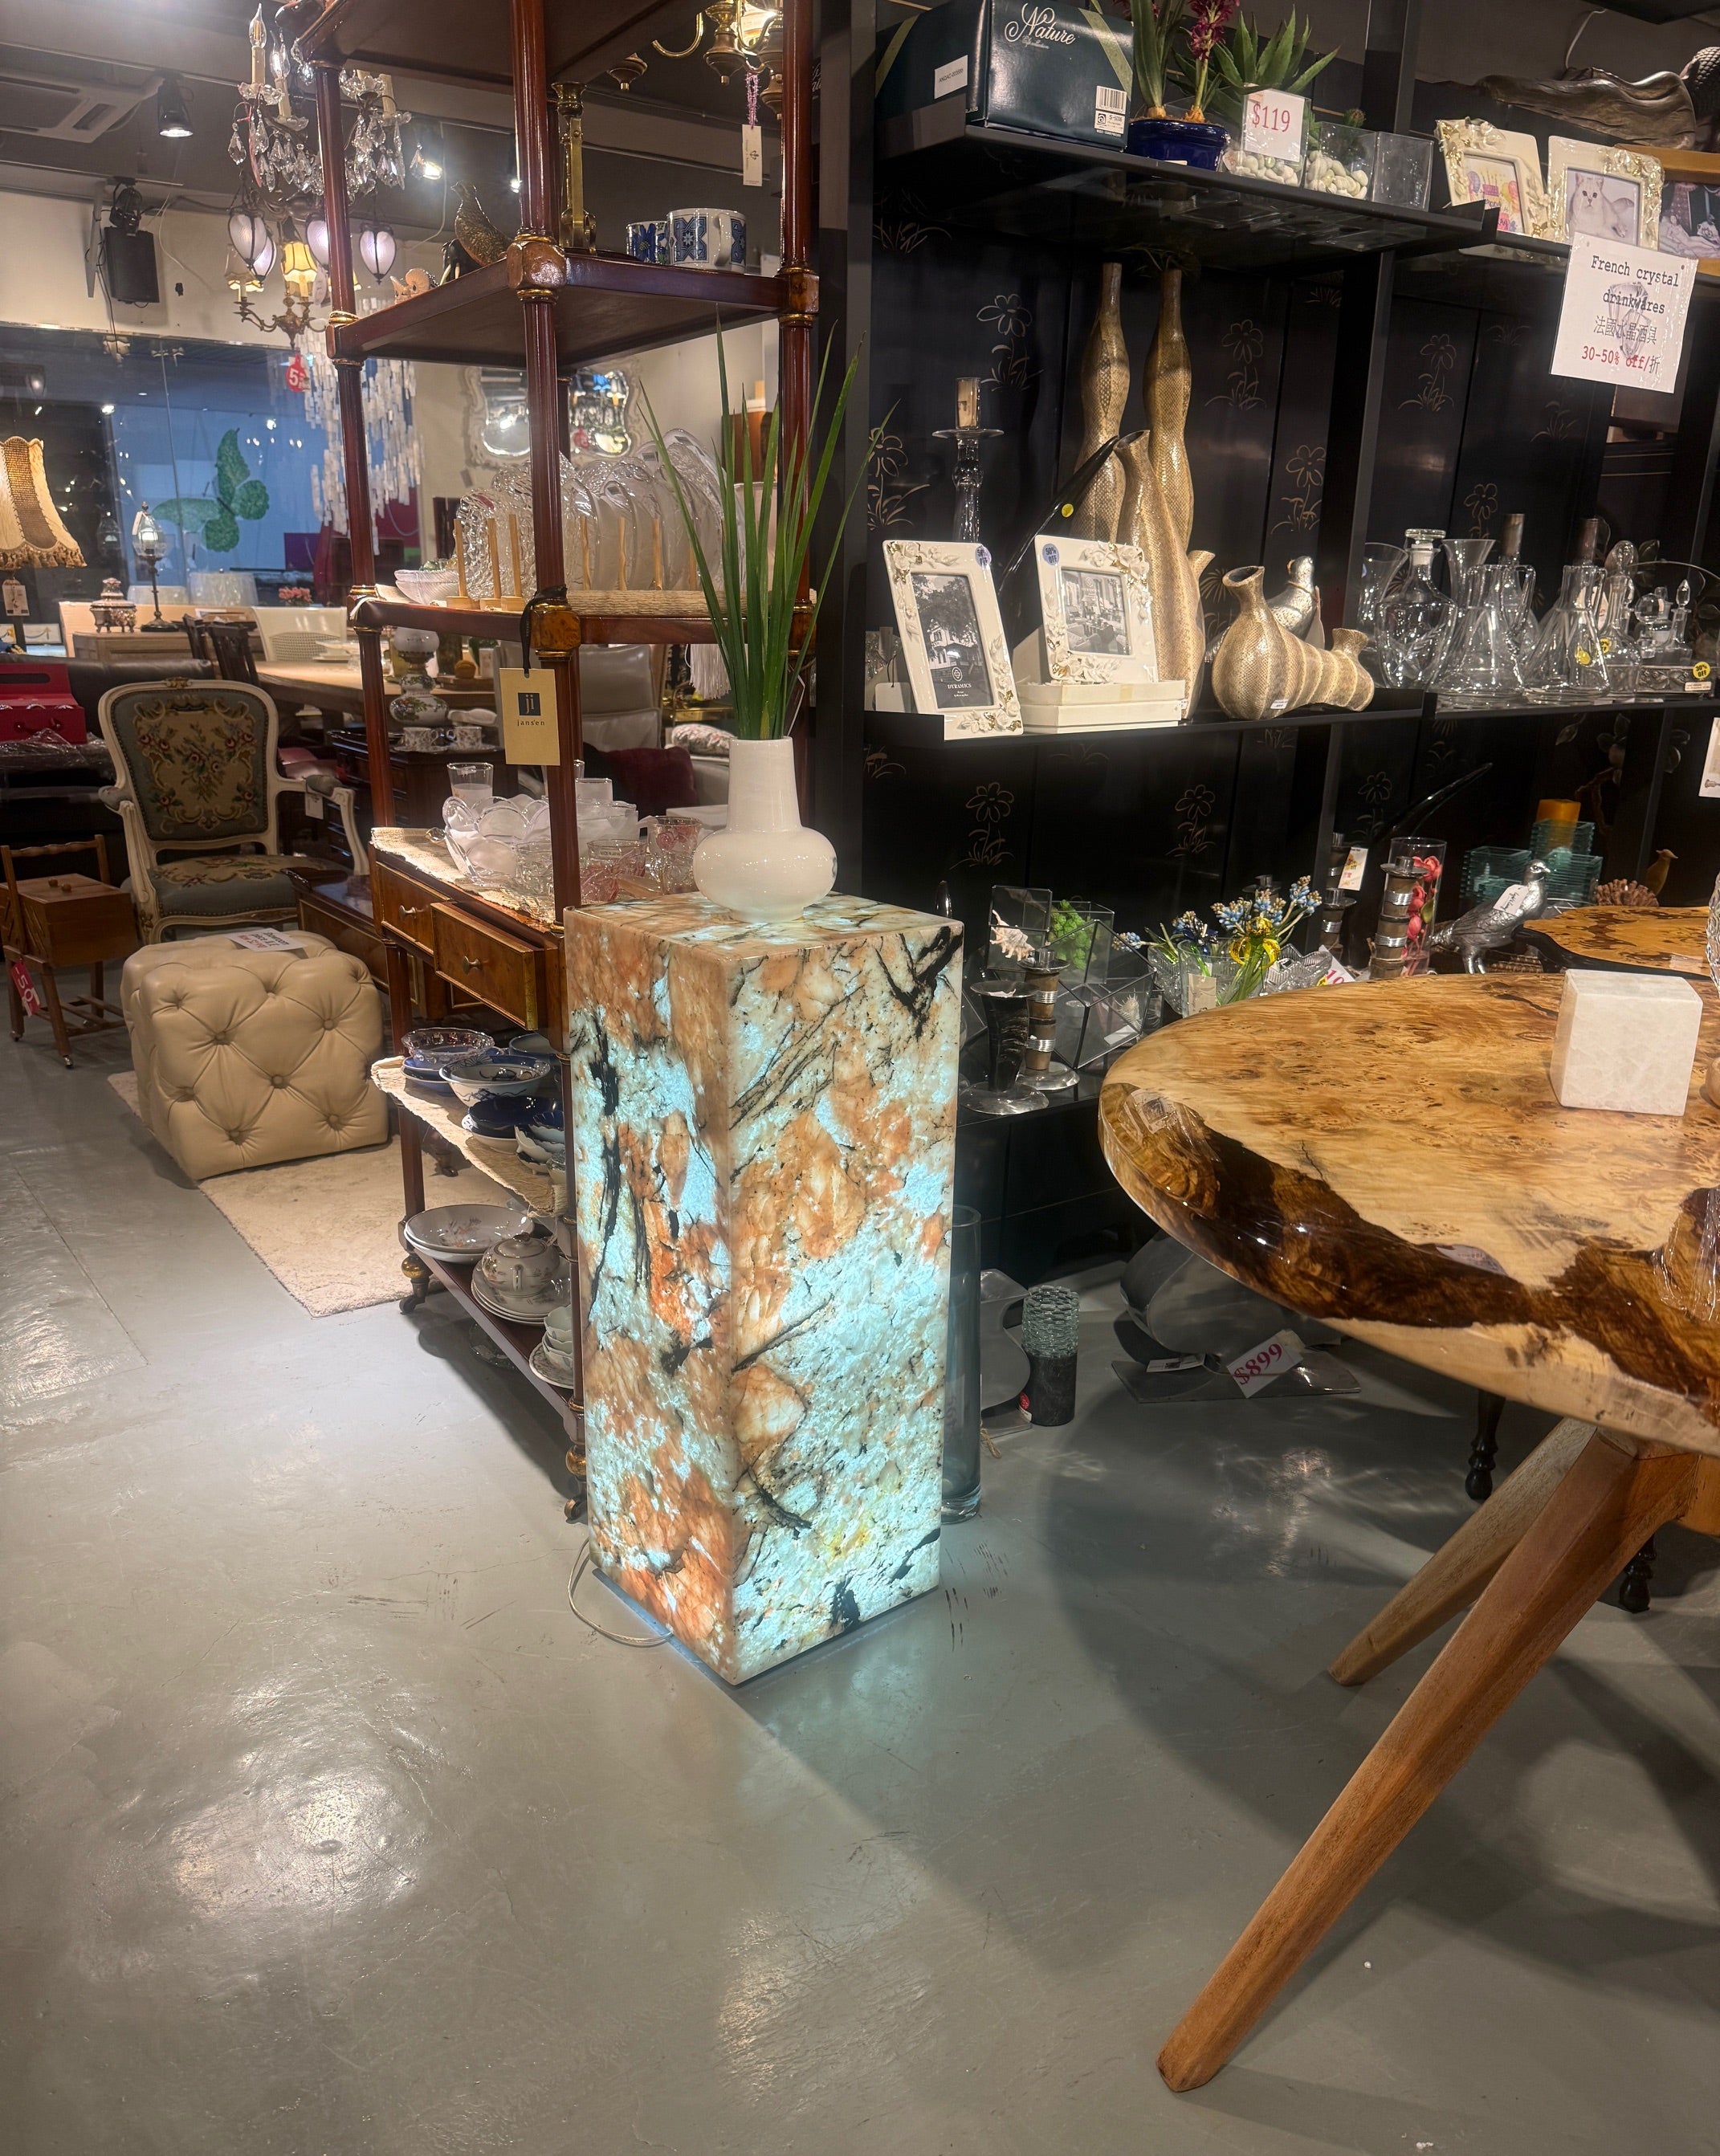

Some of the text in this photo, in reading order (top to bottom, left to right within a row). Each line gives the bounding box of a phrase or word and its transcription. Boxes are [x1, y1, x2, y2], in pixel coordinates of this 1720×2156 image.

[1004, 2, 1076, 45] Nature
[1252, 102, 1290, 132] $119
[1591, 255, 1679, 287] French crystal
[1603, 289, 1665, 314] drinkwares
[1593, 315, 1657, 345] 法國水晶酒具
[1582, 345, 1620, 365] 30-50%
[1233, 1343, 1283, 1385] $899
